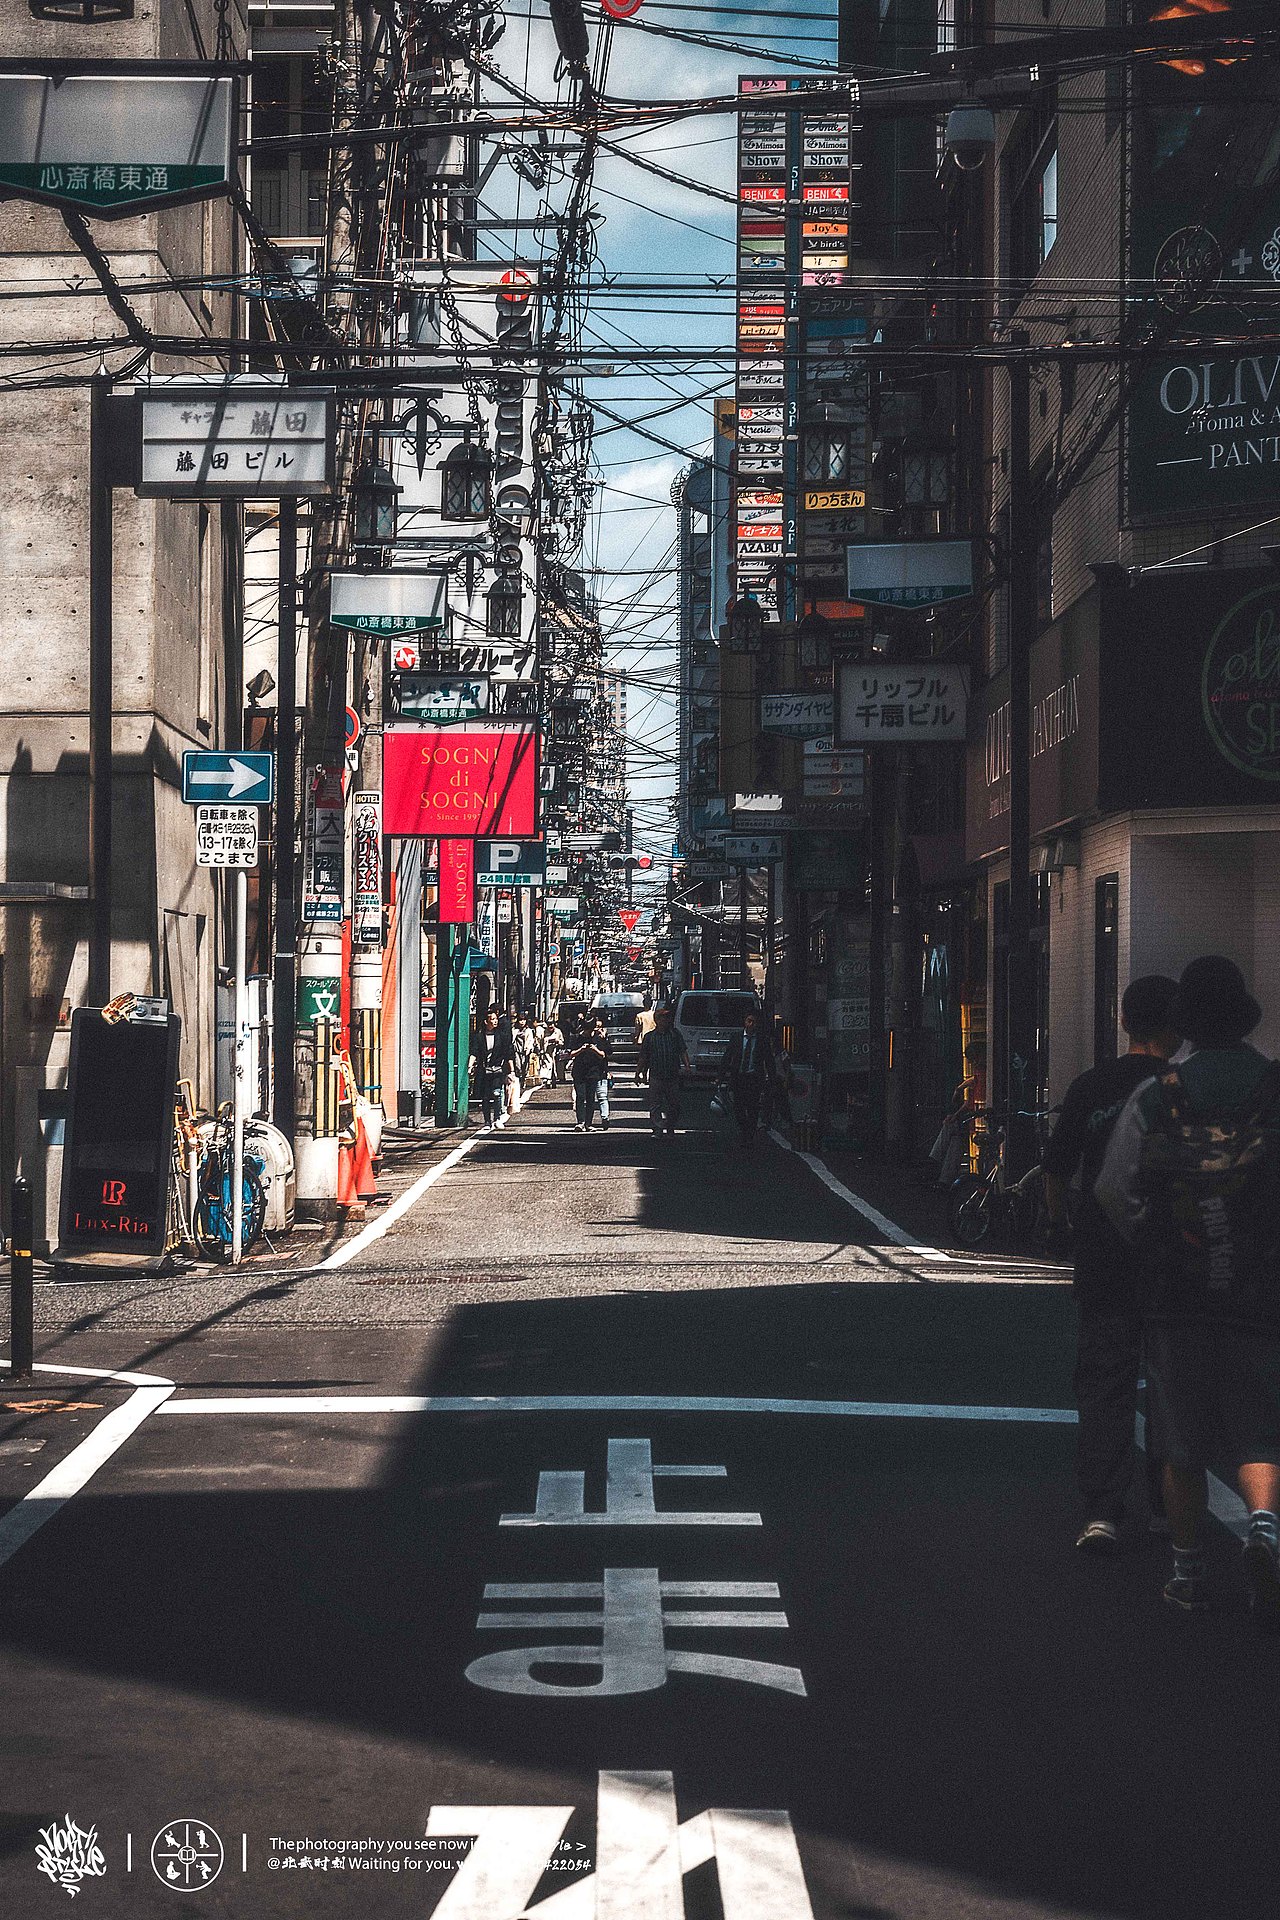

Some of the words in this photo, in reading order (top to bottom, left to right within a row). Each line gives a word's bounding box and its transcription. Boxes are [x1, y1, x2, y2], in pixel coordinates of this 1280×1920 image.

[747, 155, 780, 166] Show
[810, 155, 843, 165] Show
[40, 166, 169, 190] 心斎橋東通
[744, 190, 767, 200] BENI
[807, 190, 829, 199] BENI
[812, 225, 839, 234] Joy's
[820, 240, 845, 248] bird's
[180, 410, 234, 424] ギャラー
[175, 451, 294, 472] 藤田ビル
[808, 492, 862, 508] りっちまん
[356, 616, 417, 629] 心斎橋東通
[861, 678, 948, 699] リップル
[855, 703, 955, 728] 千扇ビル
[421, 747, 499, 765] SOGNI
[450, 770, 469, 787] di
[356, 795, 379, 803] HOTEL
[420, 791, 498, 809] SOGNI
[200, 809, 256, 821] 自転車を除く
[436, 813, 460, 821] Since
[199, 852, 256, 865] ここまで
[489, 843, 521, 872] P
[456, 862, 467, 909] SOGNI
